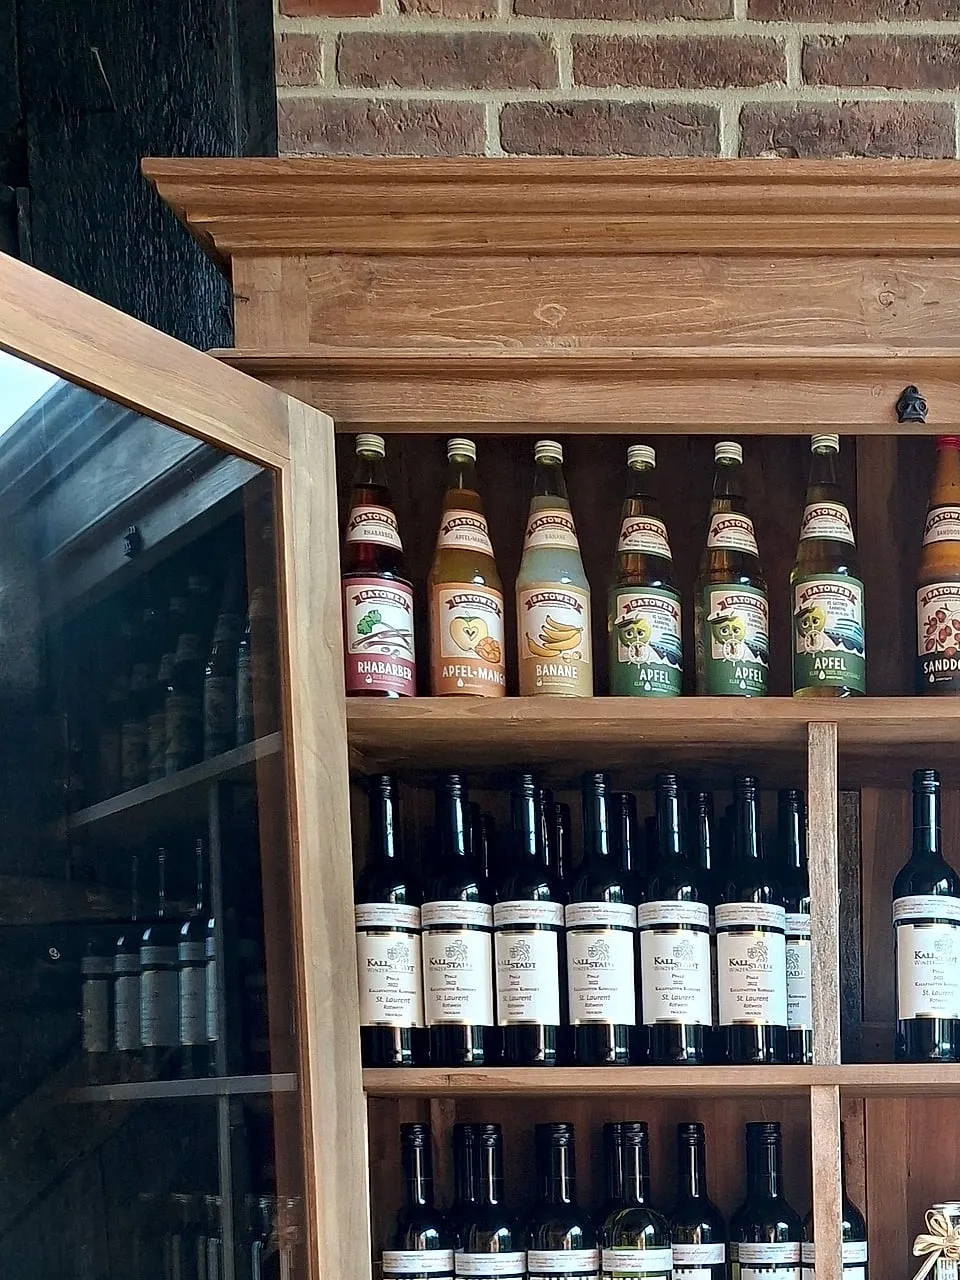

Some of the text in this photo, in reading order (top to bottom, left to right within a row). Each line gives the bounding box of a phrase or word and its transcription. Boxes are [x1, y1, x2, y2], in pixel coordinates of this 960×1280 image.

[532, 516, 572, 529] SATOWER
[362, 590, 406, 606] SATOWER
[532, 592, 576, 605] SATOWER
[806, 585, 850, 597] SATOWER
[454, 595, 497, 610] SATOWER
[631, 599, 673, 612] SATOWER
[357, 660, 412, 681] RHABARBER
[535, 664, 578, 679] BANANE
[814, 657, 847, 671] APFEL
[639, 668, 671, 684] APFEL
[734, 667, 763, 683] APFEL
